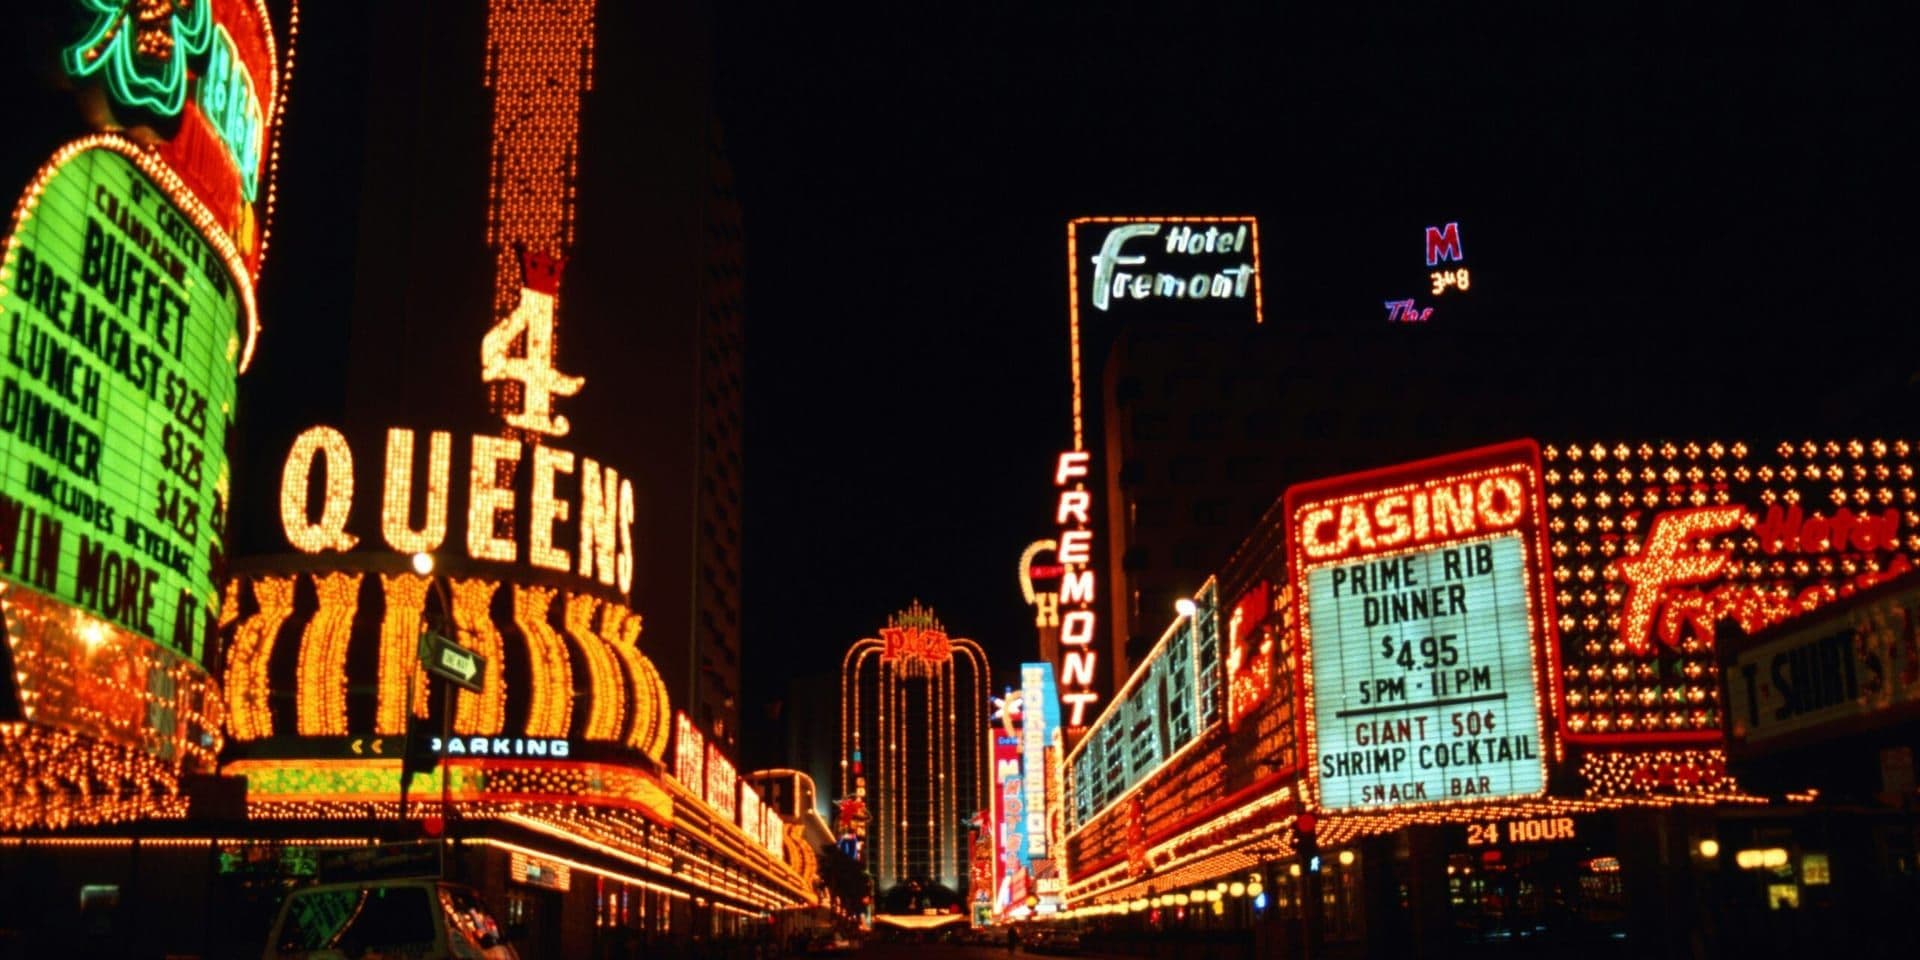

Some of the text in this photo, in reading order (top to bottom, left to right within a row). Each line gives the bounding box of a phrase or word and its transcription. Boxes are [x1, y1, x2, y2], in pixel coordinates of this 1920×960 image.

[1091, 223, 1256, 311] Fremont
[1165, 224, 1247, 255] Hotel
[1426, 222, 1463, 266] M
[15, 249, 163, 402] BREAKFAST
[82, 216, 190, 362] BUFFET
[9, 312, 101, 421] LUNCH
[481, 287, 585, 437] 4
[0, 378, 100, 487] DINNER
[25, 461, 115, 535] INCLUDES
[280, 425, 634, 595] QUEENS
[1302, 476, 1522, 557] CASINO
[75, 533, 161, 638] MORE
[1055, 451, 1098, 727] FREMONT
[1332, 543, 1494, 599] PRIME RIB
[1363, 583, 1468, 628] DINNER
[1382, 634, 1459, 672] $4.95
[1322, 734, 1537, 779] SHRIMP COCKTAIL
[1356, 709, 1496, 747] GIANT 50¢
[1362, 776, 1490, 803] SNACK BAR
[1467, 818, 1576, 846] 24 HOUR
